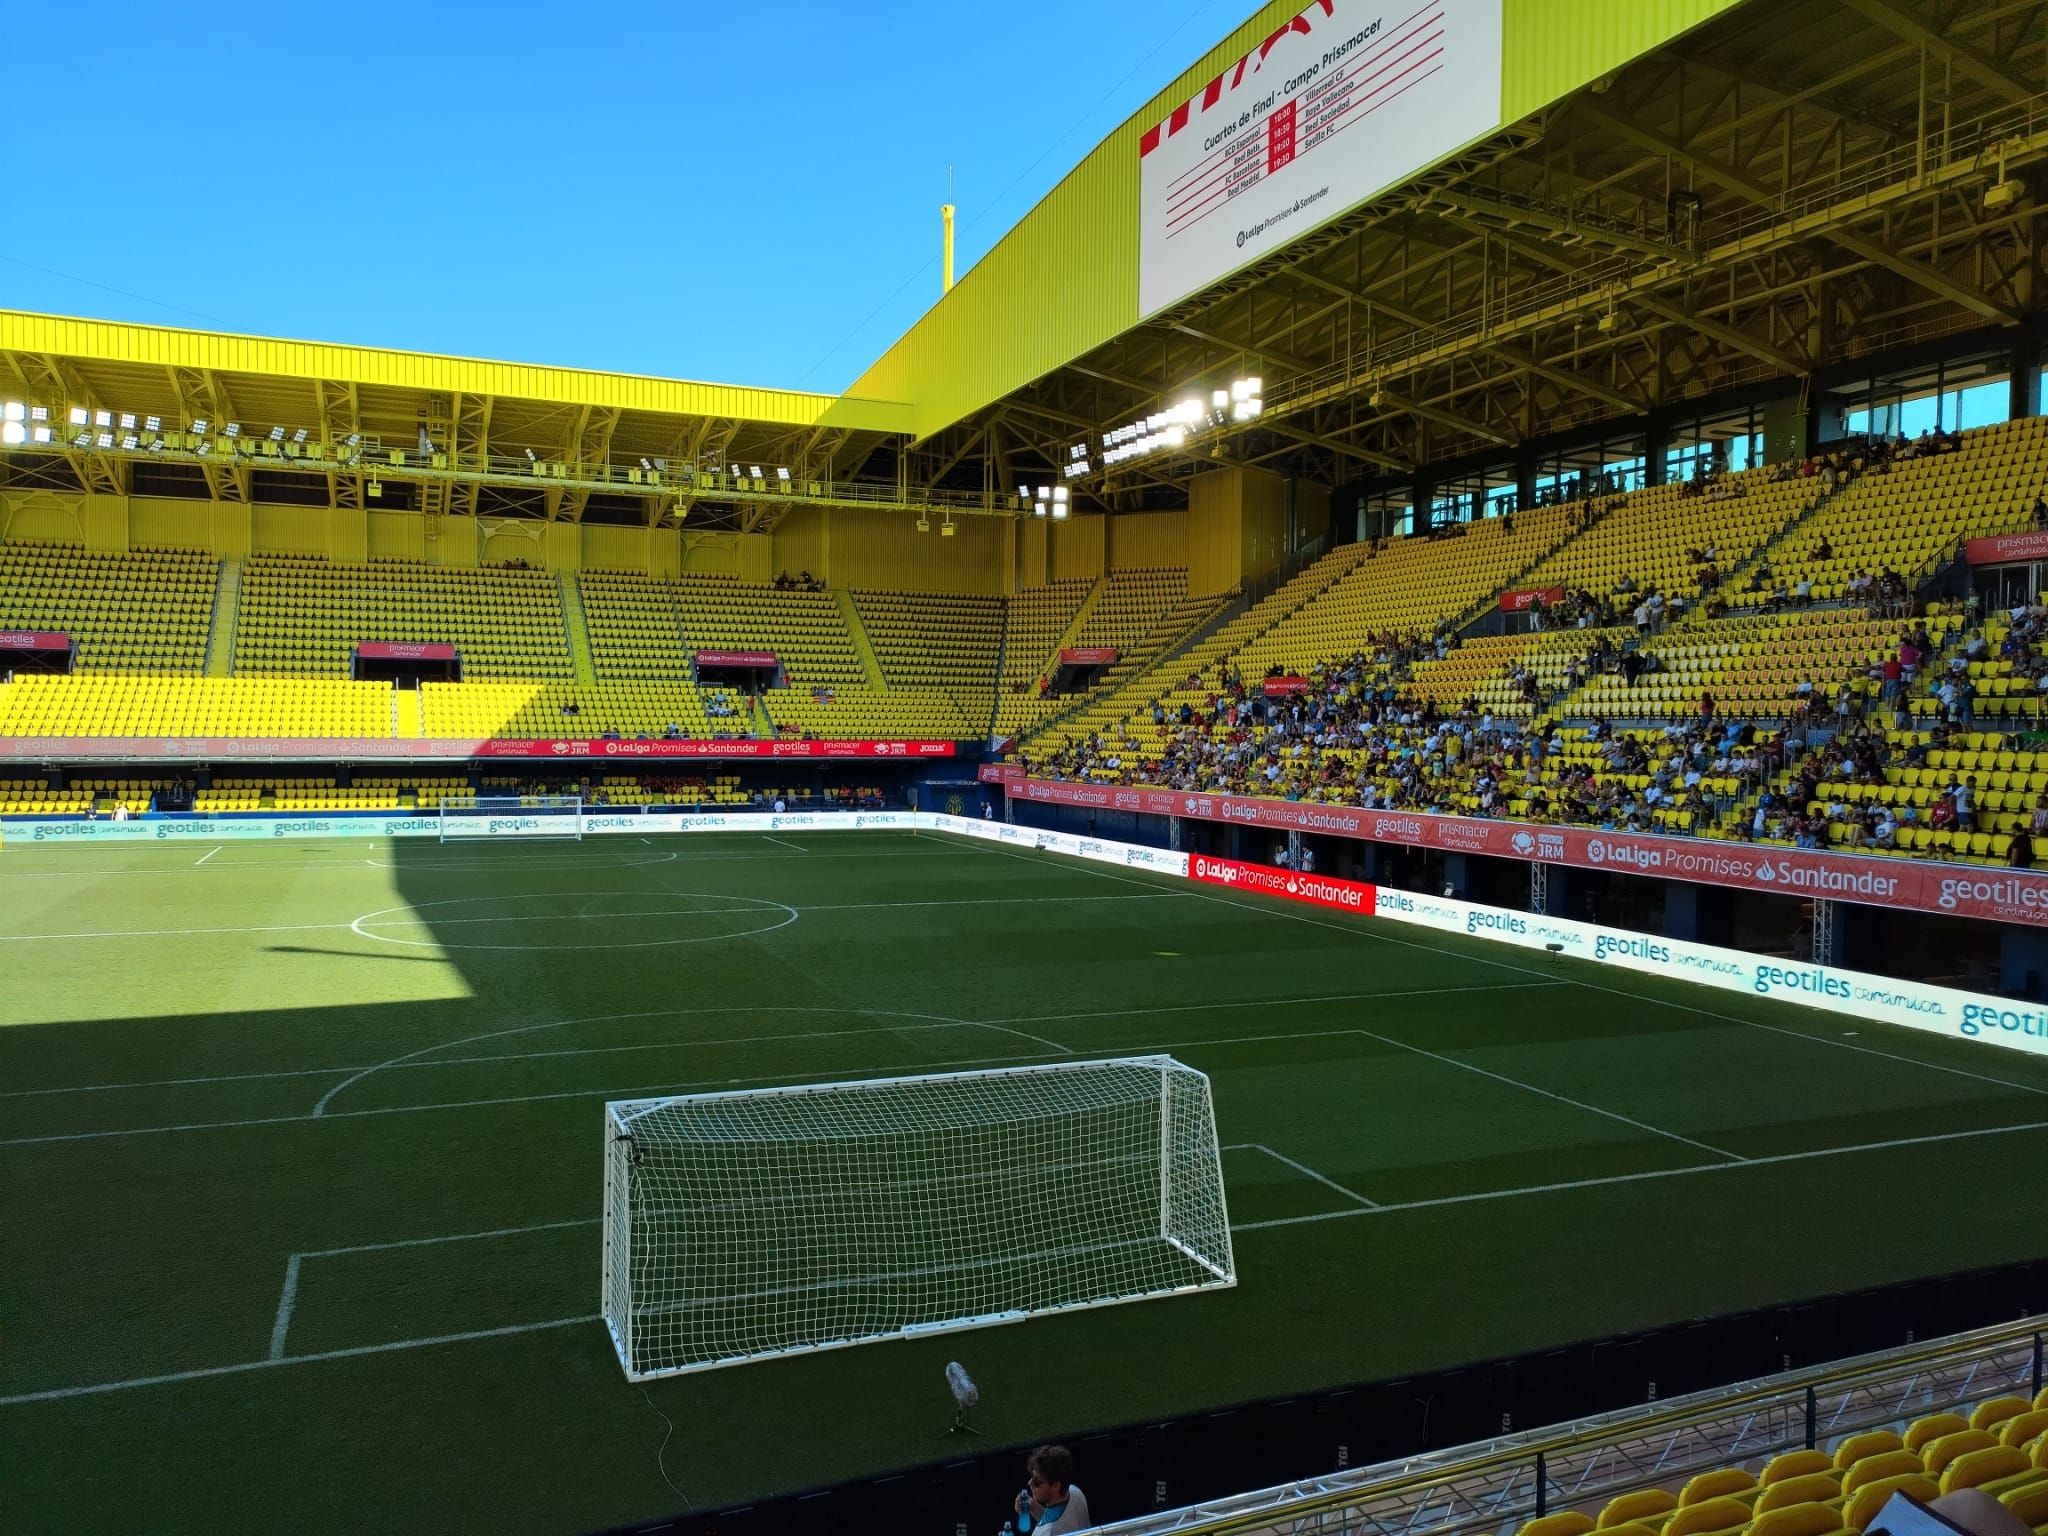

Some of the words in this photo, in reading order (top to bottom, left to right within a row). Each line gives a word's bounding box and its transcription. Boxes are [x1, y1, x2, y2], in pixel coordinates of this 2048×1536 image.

[1204, 123, 1237, 151] Cuartos
[1238, 112, 1250, 128] de
[1252, 91, 1274, 118] Final
[1284, 64, 1319, 95] Campo
[1322, 17, 1382, 69] Prissmacer
[1305, 76, 1334, 102] Villarreal
[1336, 70, 1344, 82] CF
[1305, 102, 1321, 118] Rayo
[1322, 82, 1354, 107] Vallecano
[1274, 106, 1291, 124] 18:00
[1305, 120, 1318, 134] Real
[1320, 98, 1350, 121] Sociedad
[1274, 122, 1291, 139] 18:30
[1304, 132, 1326, 149] Sevilla
[1326, 123, 1335, 136] FC
[1234, 152, 1246, 166] Real
[1225, 174, 1232, 186] FC
[1232, 158, 1260, 181] Barcelona
[1228, 185, 1240, 198] Real
[1240, 171, 1260, 192] Madrid
[1245, 224, 1264, 240] LaLiga
[1264, 206, 1292, 230] Promises
[1300, 186, 1330, 208] Santander
[14, 738, 69, 754] geotiles
[242, 742, 280, 753] LaLiga
[352, 742, 412, 752] Santander
[430, 740, 474, 754] geotiles
[618, 742, 650, 754] LaLiga
[651, 742, 696, 752] Promises
[708, 744, 758, 753] Santander
[773, 742, 810, 754] geotiles
[1050, 786, 1073, 799] Promises
[1078, 790, 1107, 804] Santander
[1114, 792, 1140, 807] geotiles
[1198, 806, 1212, 816] JRM
[1231, 804, 1257, 820] LaLiga
[1258, 807, 1298, 824] Promises
[1307, 812, 1360, 832] Santander
[274, 820, 330, 837] geotiles
[384, 818, 438, 834] geotiles
[489, 818, 539, 832] geotiles
[586, 816, 634, 831] geotiles
[681, 816, 726, 830] geotiles
[772, 816, 814, 829] geotiles
[856, 814, 896, 827] geotiles
[1375, 816, 1421, 838] geotiles
[34, 822, 96, 840] geotiles
[156, 822, 215, 838] geotiles
[1126, 848, 1154, 864] geotiles
[1537, 844, 1564, 860] JRM
[1607, 843, 1661, 868] LaLiga
[1664, 848, 1753, 878] Promises
[1778, 861, 1898, 896] Santander
[1206, 861, 1237, 882] LaLiga
[1238, 865, 1286, 890] Promises
[1298, 878, 1364, 907] Santander
[1938, 878, 2048, 908] geotiles
[1467, 910, 1527, 934] geotiles
[1594, 934, 1671, 962] geotiles
[1754, 964, 1851, 999] geotiles
[1960, 1002, 2048, 1037] geoti
[1502, 1412, 1512, 1433] TGI
[1338, 1444, 1349, 1467] TGI
[1156, 1480, 1167, 1504] TGI
